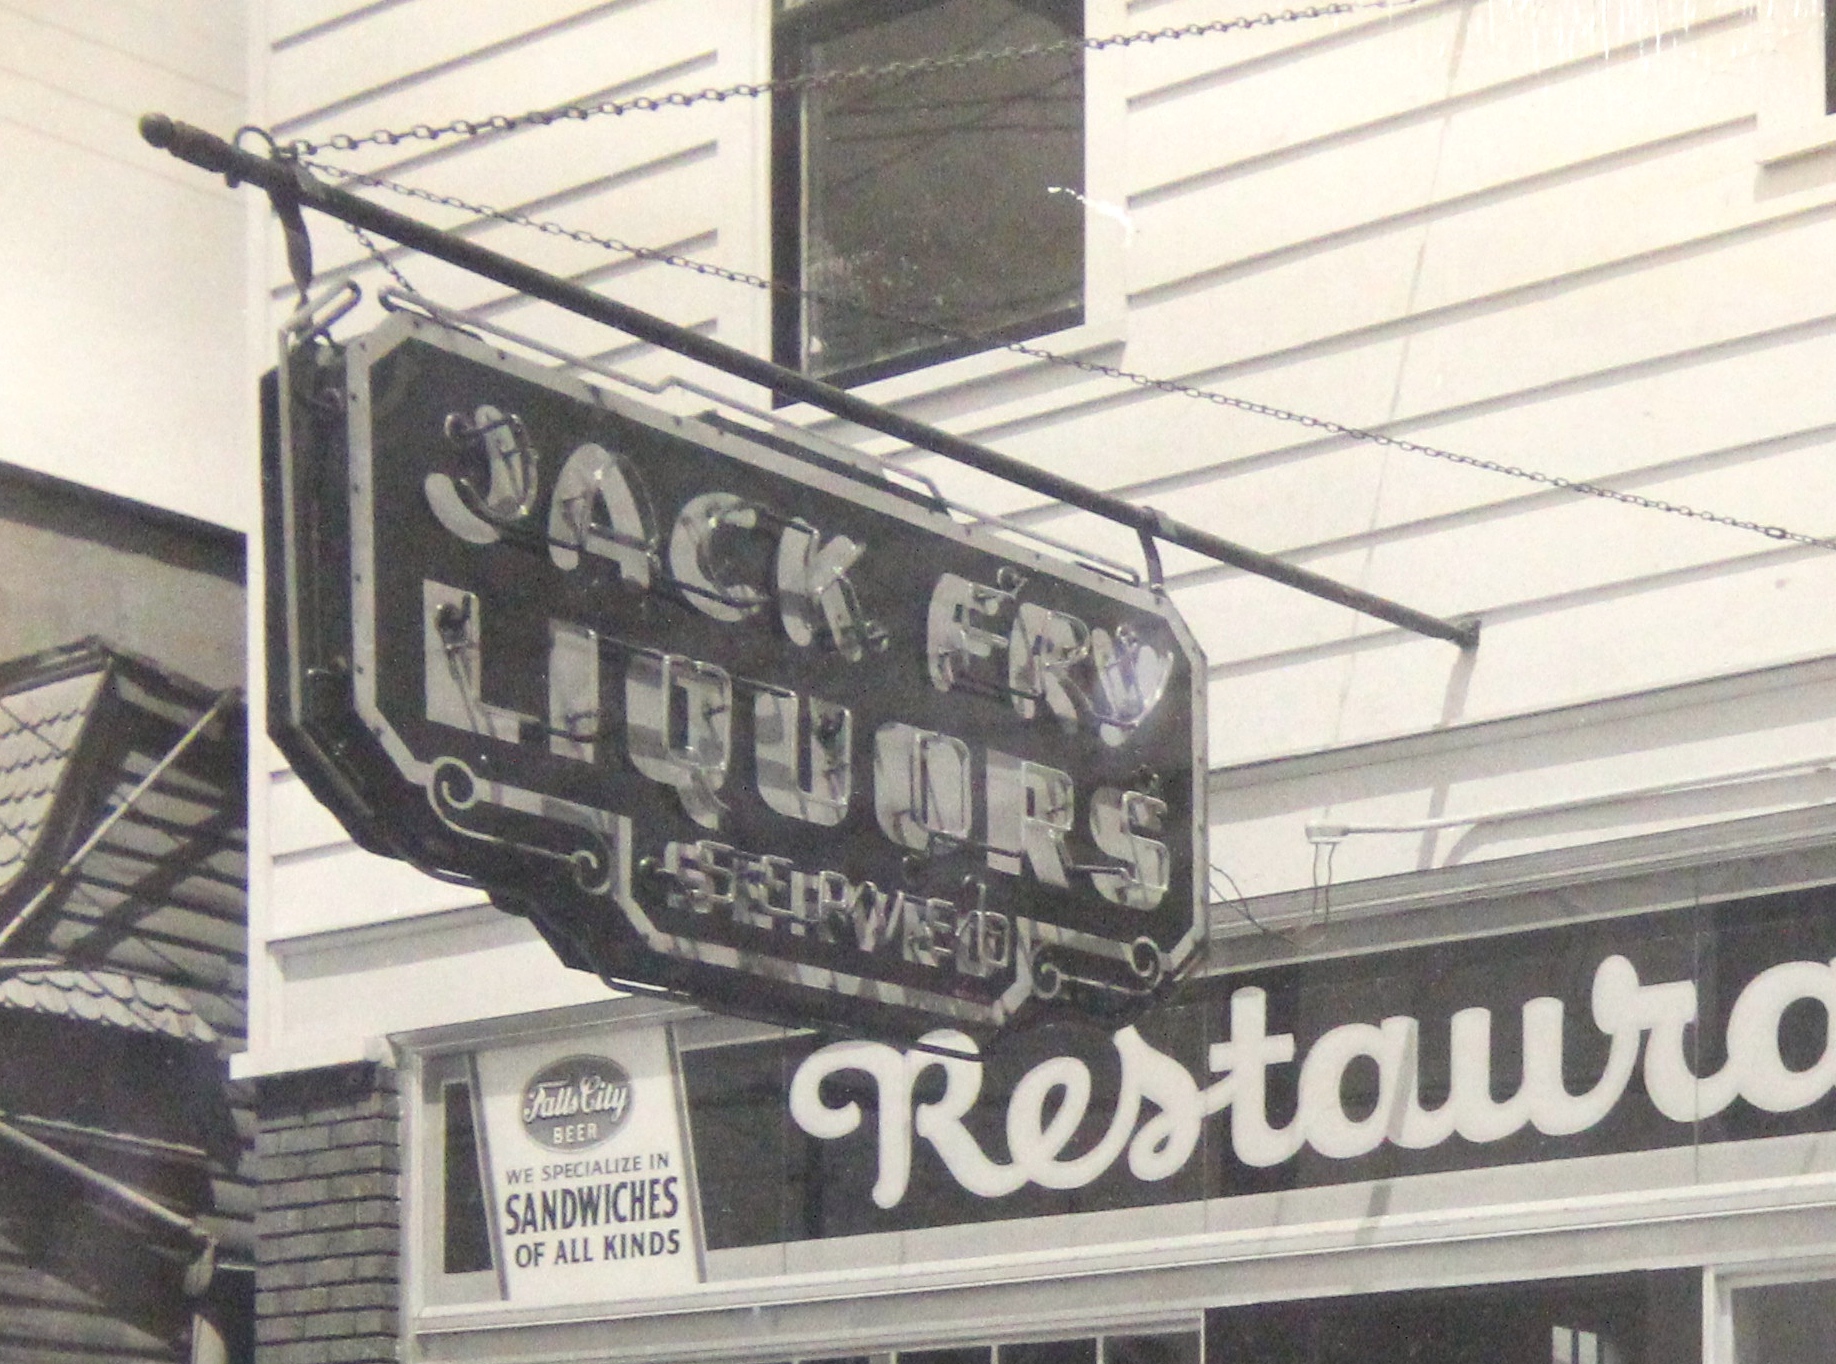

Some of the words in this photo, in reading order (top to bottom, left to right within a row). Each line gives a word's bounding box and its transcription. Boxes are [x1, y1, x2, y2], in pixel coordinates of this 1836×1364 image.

[424, 404, 880, 662] JACK
[422, 579, 1170, 910] LIQUORS
[523, 1080, 577, 1124] Falls
[577, 1074, 628, 1122] City
[553, 1122, 598, 1145] BEER
[506, 1167, 533, 1186] WE
[540, 1155, 642, 1182] SPECIALIZE
[650, 1152, 670, 1171] IN
[505, 1176, 679, 1236] SANDWICHES
[515, 1242, 546, 1268] OF
[554, 1238, 594, 1266] ALL
[603, 1229, 681, 1261] KINDS
